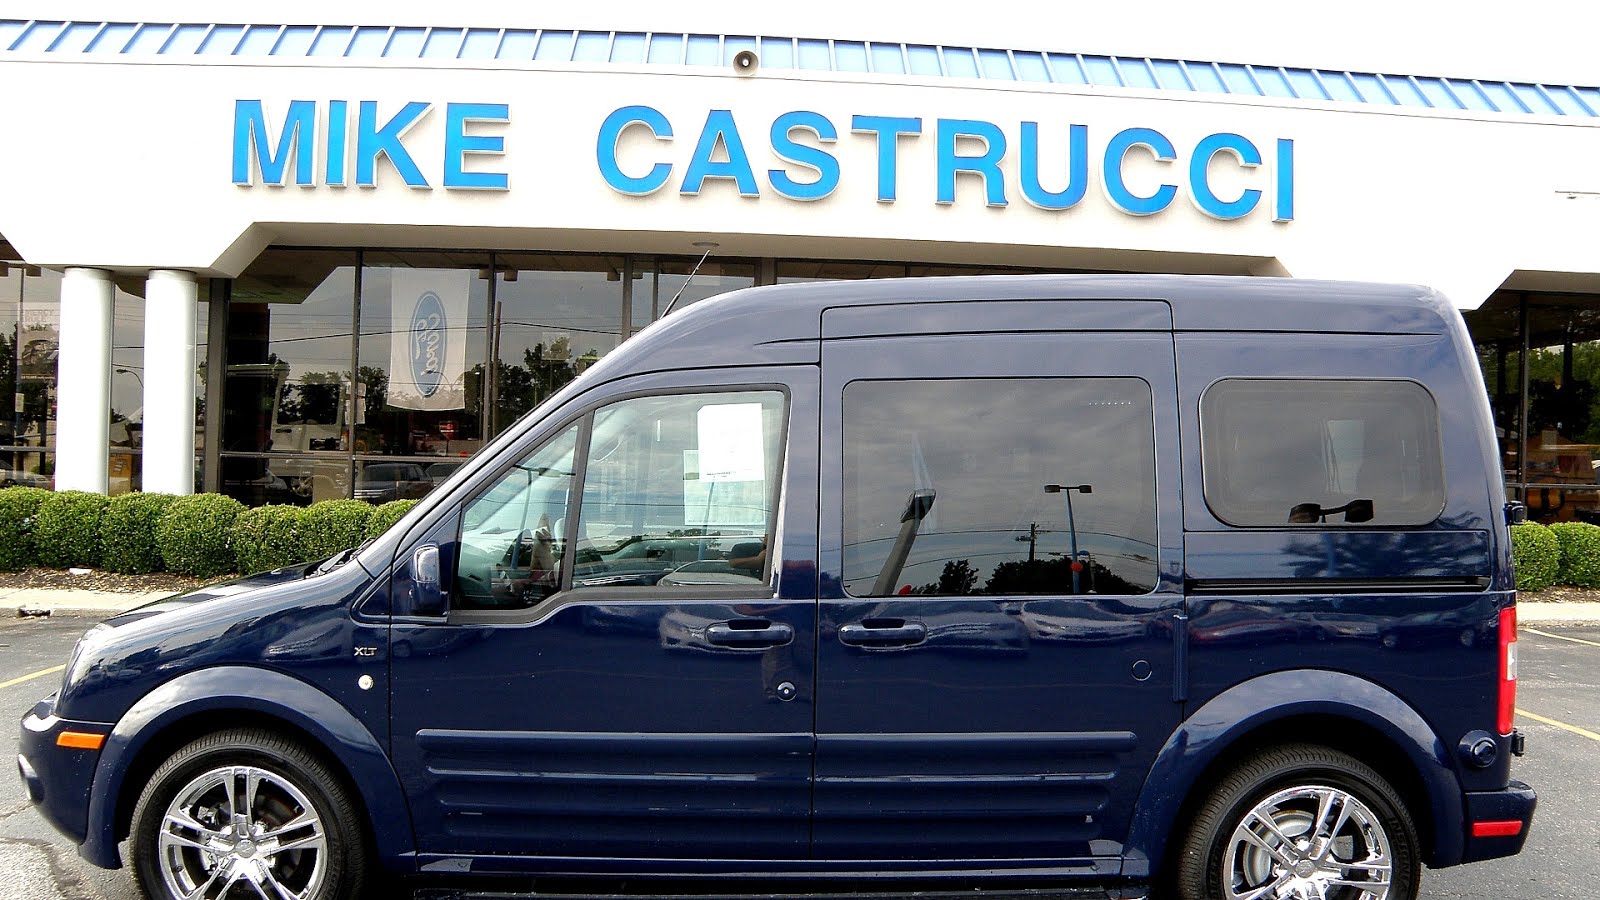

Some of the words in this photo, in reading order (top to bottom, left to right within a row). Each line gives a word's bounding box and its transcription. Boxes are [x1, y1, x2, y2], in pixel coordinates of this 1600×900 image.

[231, 99, 511, 191] MIKE
[596, 104, 1294, 223] CASTRUCCI
[354, 646, 377, 656] XLT
